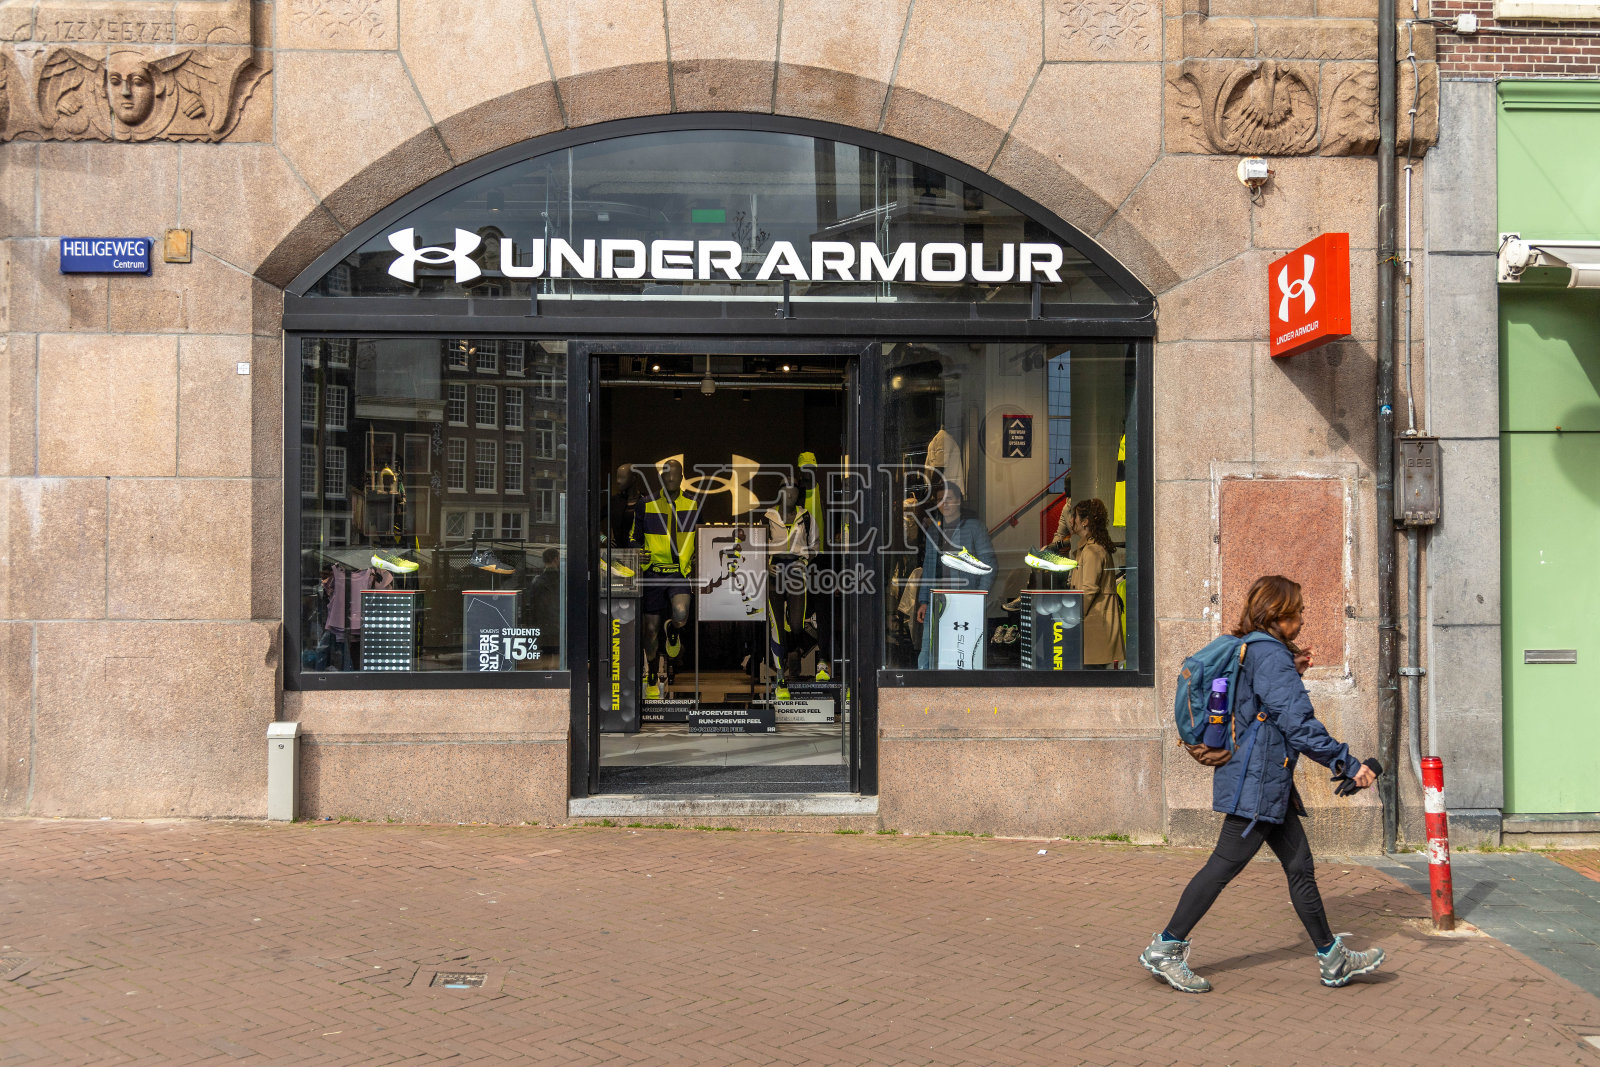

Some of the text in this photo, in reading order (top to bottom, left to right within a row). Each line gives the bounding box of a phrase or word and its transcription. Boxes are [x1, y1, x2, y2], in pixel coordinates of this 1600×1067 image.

[64, 241, 145, 256] HEILIGEWEG
[113, 259, 144, 269] Centrum
[500, 237, 1064, 282] UNDER ARMOUR
[1276, 320, 1319, 345] UNDER ARMOUR
[502, 628, 540, 636] STUDENTS
[1053, 621, 1063, 644] UA
[480, 635, 490, 671] REIGN
[490, 635, 499, 653] UA
[527, 652, 540, 660] OFF
[611, 618, 620, 711] UA INFINITE ELITE
